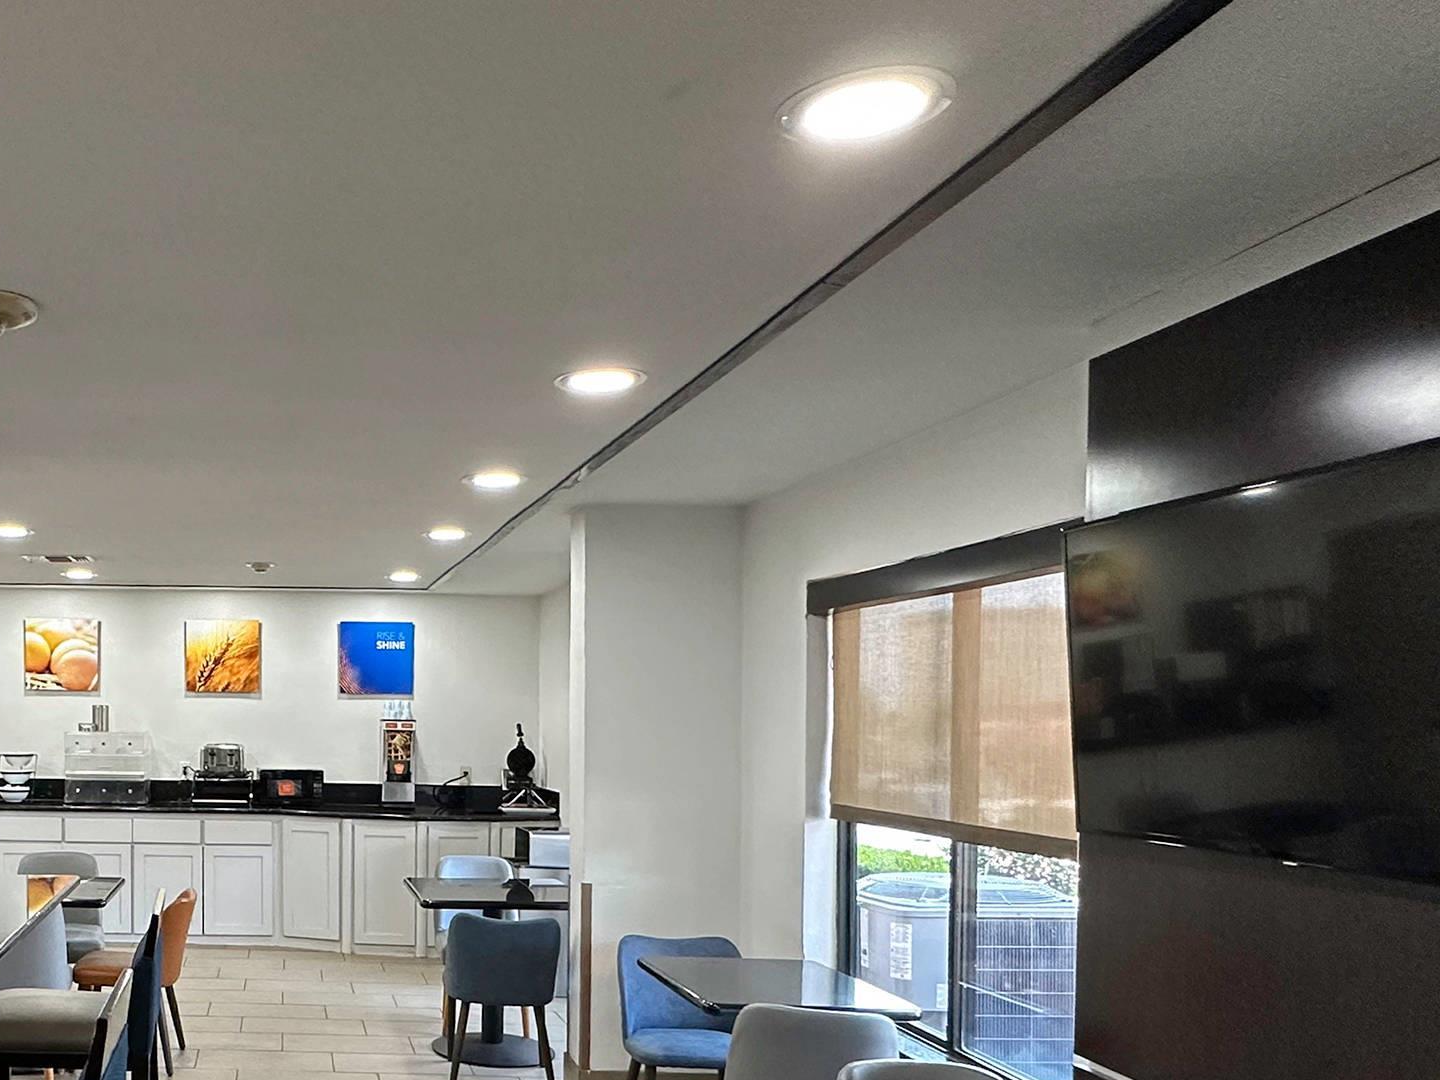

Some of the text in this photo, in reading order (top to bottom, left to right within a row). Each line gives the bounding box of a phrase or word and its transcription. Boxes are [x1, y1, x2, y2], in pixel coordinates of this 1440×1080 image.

[376, 631, 405, 640] RISE &
[376, 641, 406, 650] SHINE
